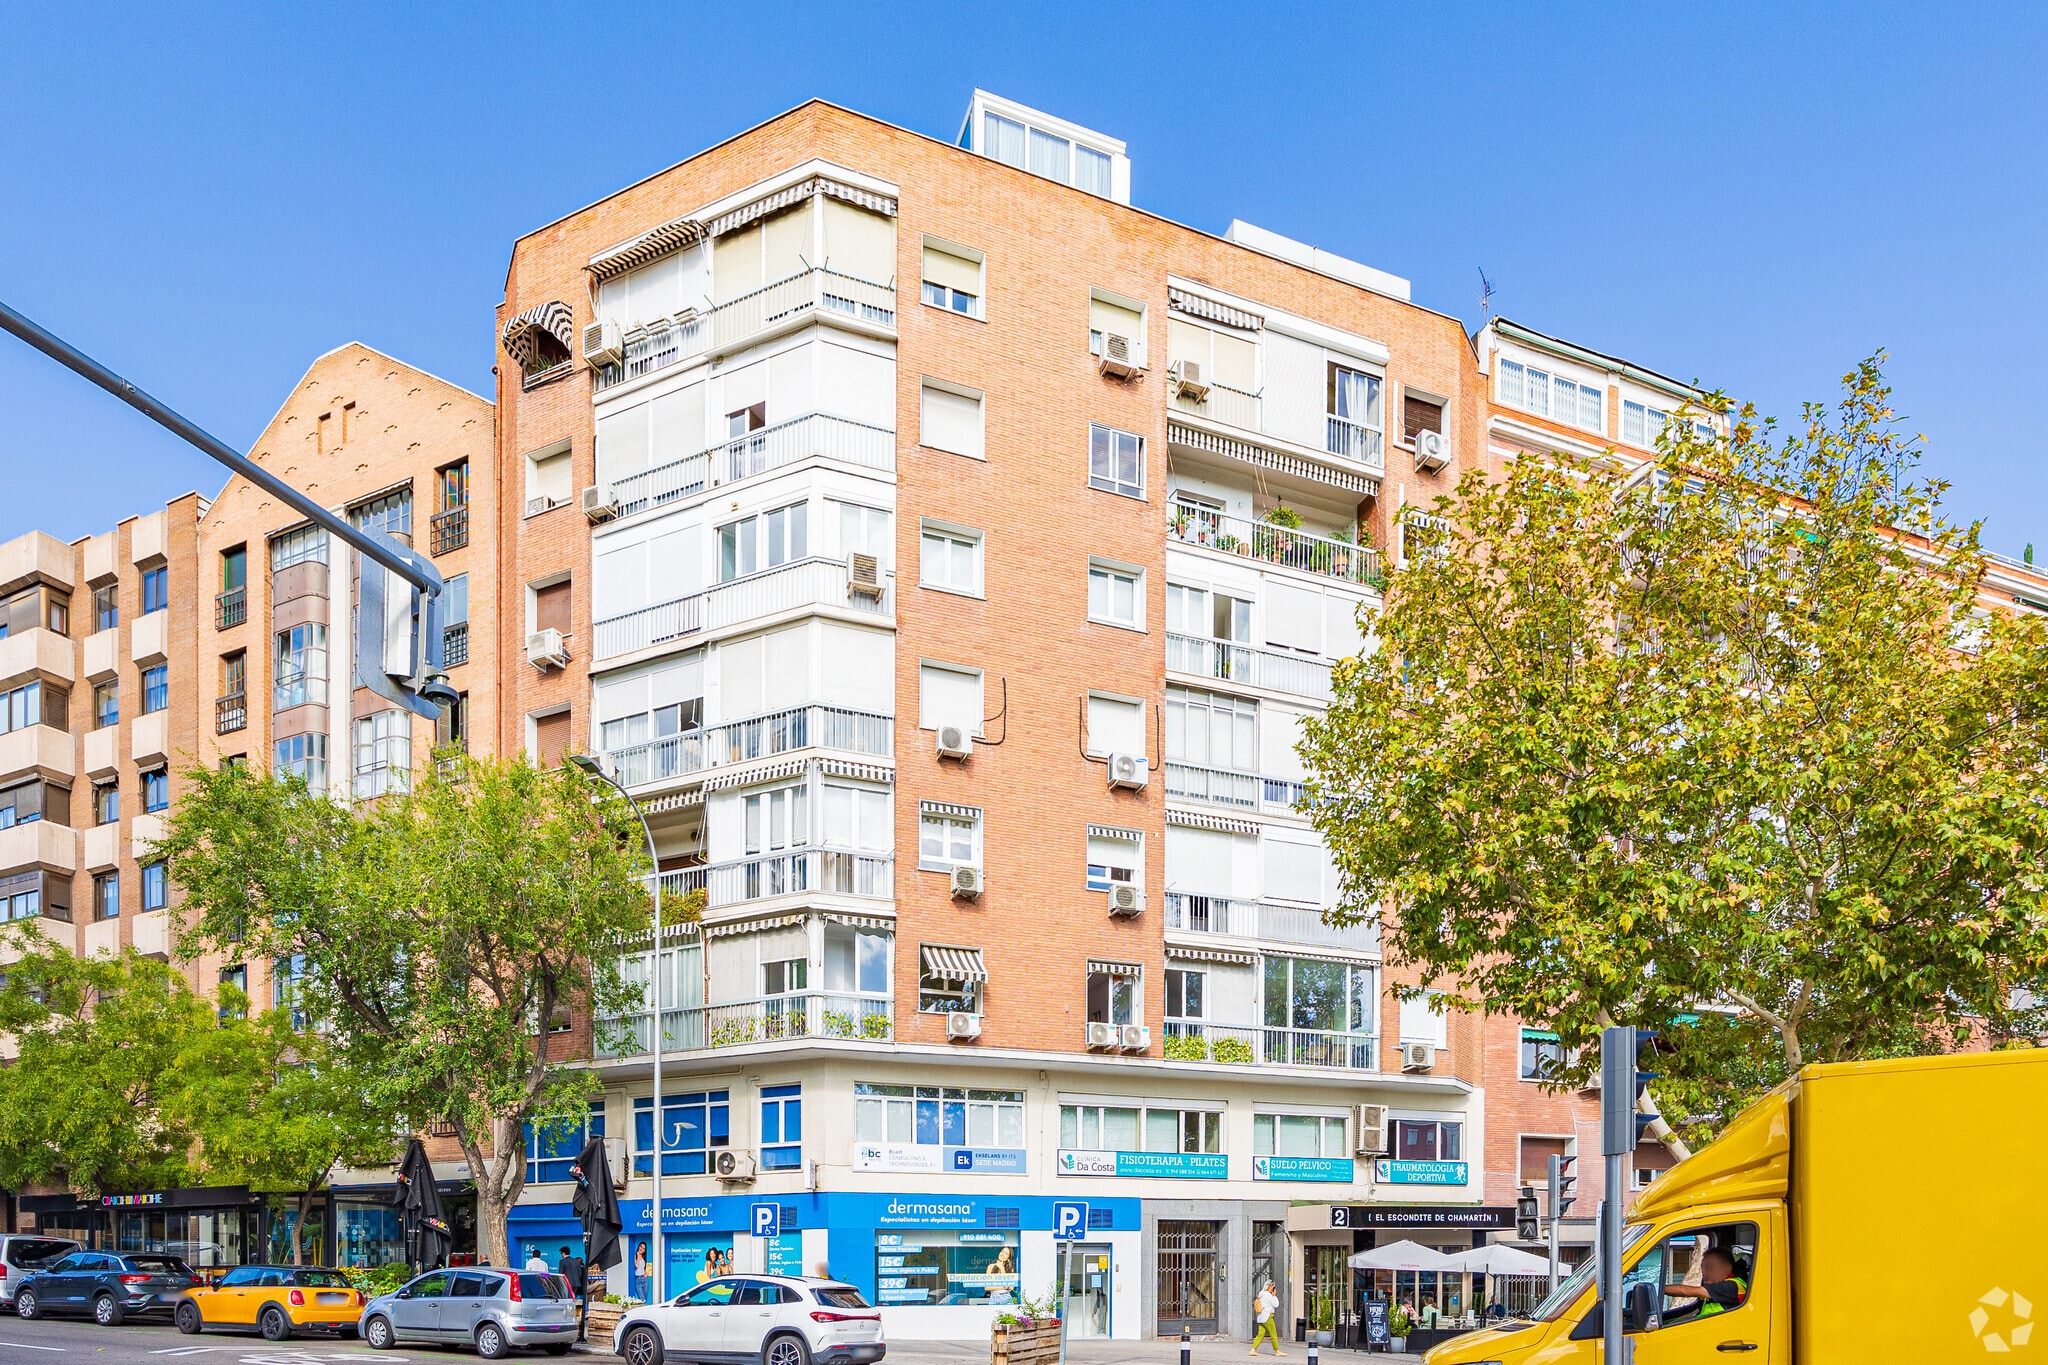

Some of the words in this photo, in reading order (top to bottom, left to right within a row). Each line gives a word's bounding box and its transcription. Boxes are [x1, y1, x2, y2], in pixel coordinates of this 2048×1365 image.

[868, 1149, 881, 1158] bc
[957, 1155, 970, 1165] Ek
[1119, 1155, 1183, 1166] FISIOTERAPIA
[1190, 1158, 1226, 1168] PILATES
[1271, 1160, 1297, 1169] SUELO
[1077, 1162, 1089, 1171] Da
[1091, 1163, 1115, 1172] Costa
[1407, 1173, 1446, 1182] DEPORTIVA
[642, 1204, 708, 1218] demasana
[888, 1198, 971, 1215] dermasana
[757, 1208, 773, 1233] P
[1060, 1207, 1080, 1235] P
[1334, 1209, 1345, 1225] 2
[1448, 1213, 1492, 1222] CHAMARTÍN
[769, 1239, 780, 1247] 8€
[880, 1235, 898, 1245] 8€
[881, 1256, 902, 1267] 15€
[881, 1278, 904, 1288] 39€
